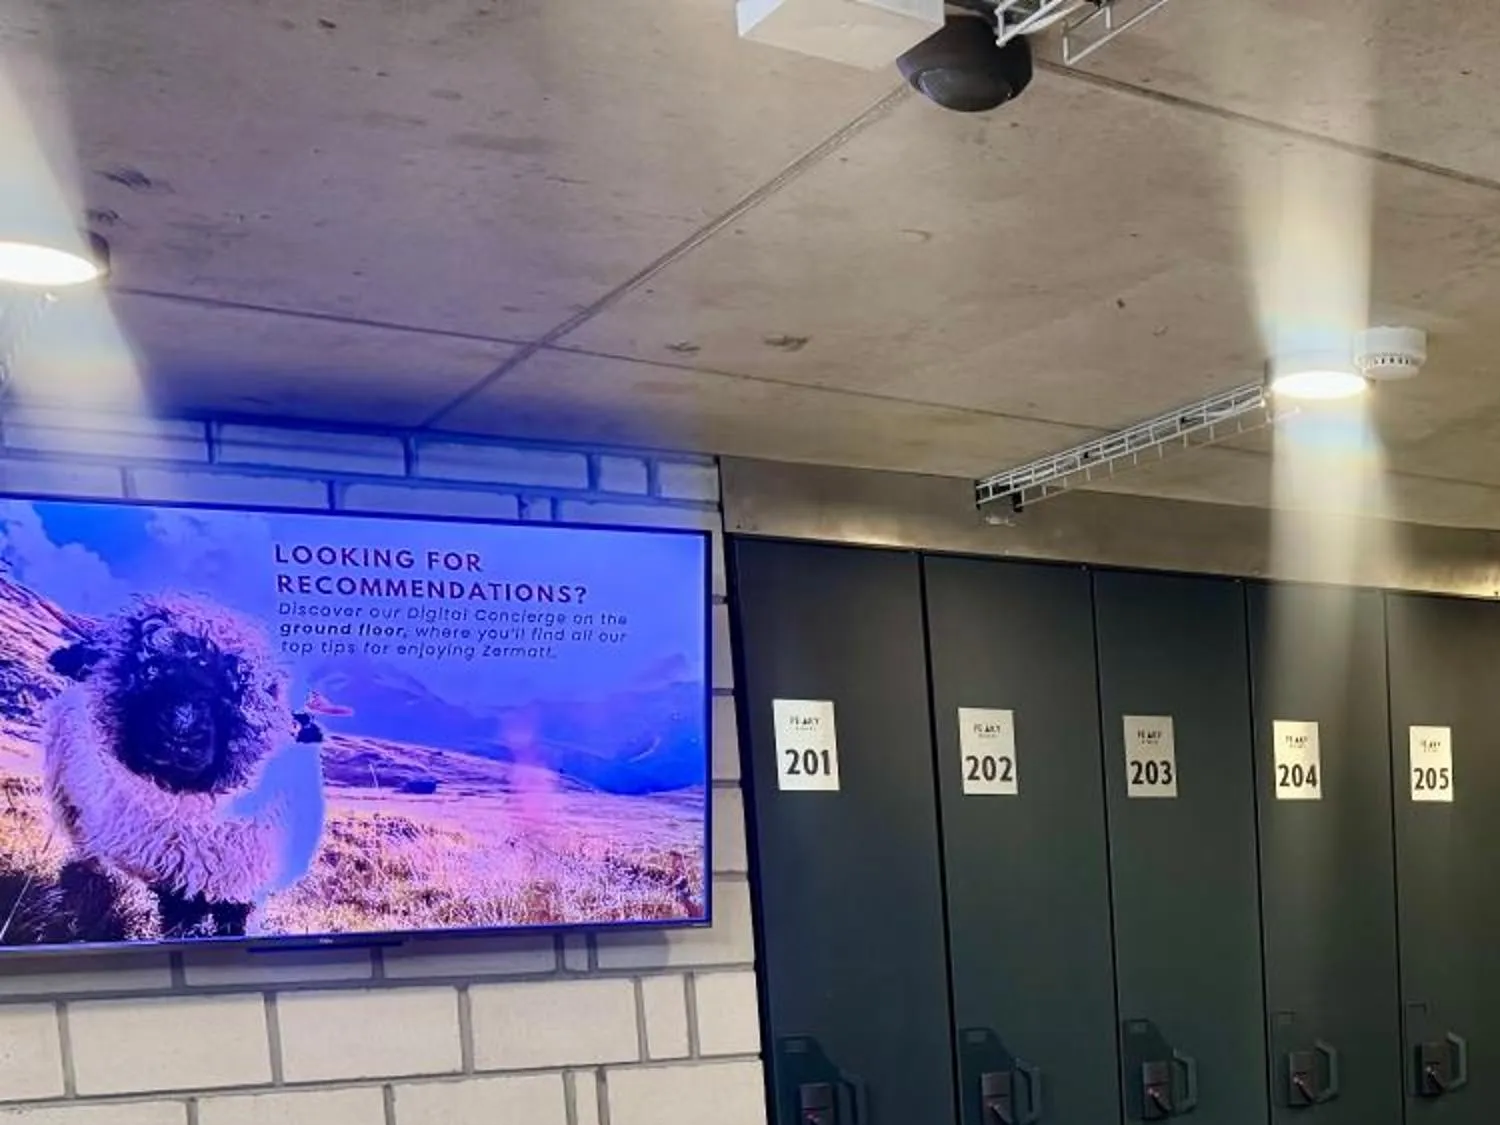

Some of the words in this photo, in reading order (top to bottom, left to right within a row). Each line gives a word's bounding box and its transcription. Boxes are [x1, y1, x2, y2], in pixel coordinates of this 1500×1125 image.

[275, 543, 415, 569] LOOKING
[427, 551, 483, 572] FOR
[277, 574, 587, 604] RECOMMENDATIONS?
[279, 602, 362, 617] Discover
[369, 607, 400, 619] our
[407, 604, 467, 623] Digital
[474, 608, 566, 627] Concierge
[573, 614, 593, 625] on
[601, 613, 628, 625] the
[279, 623, 351, 637] ground
[358, 623, 407, 639] floor,
[415, 625, 471, 639] where
[477, 627, 526, 643] you'll
[531, 627, 565, 641] find
[571, 629, 593, 642] all
[598, 631, 628, 643] our
[281, 640, 313, 656] top
[321, 639, 355, 656] tips
[364, 641, 389, 655] for
[397, 642, 475, 662] enjoying
[785, 748, 832, 776] 201
[965, 755, 1013, 782] 202
[1130, 760, 1174, 787] 203
[1278, 763, 1318, 788] 204
[1413, 767, 1450, 791] 205
